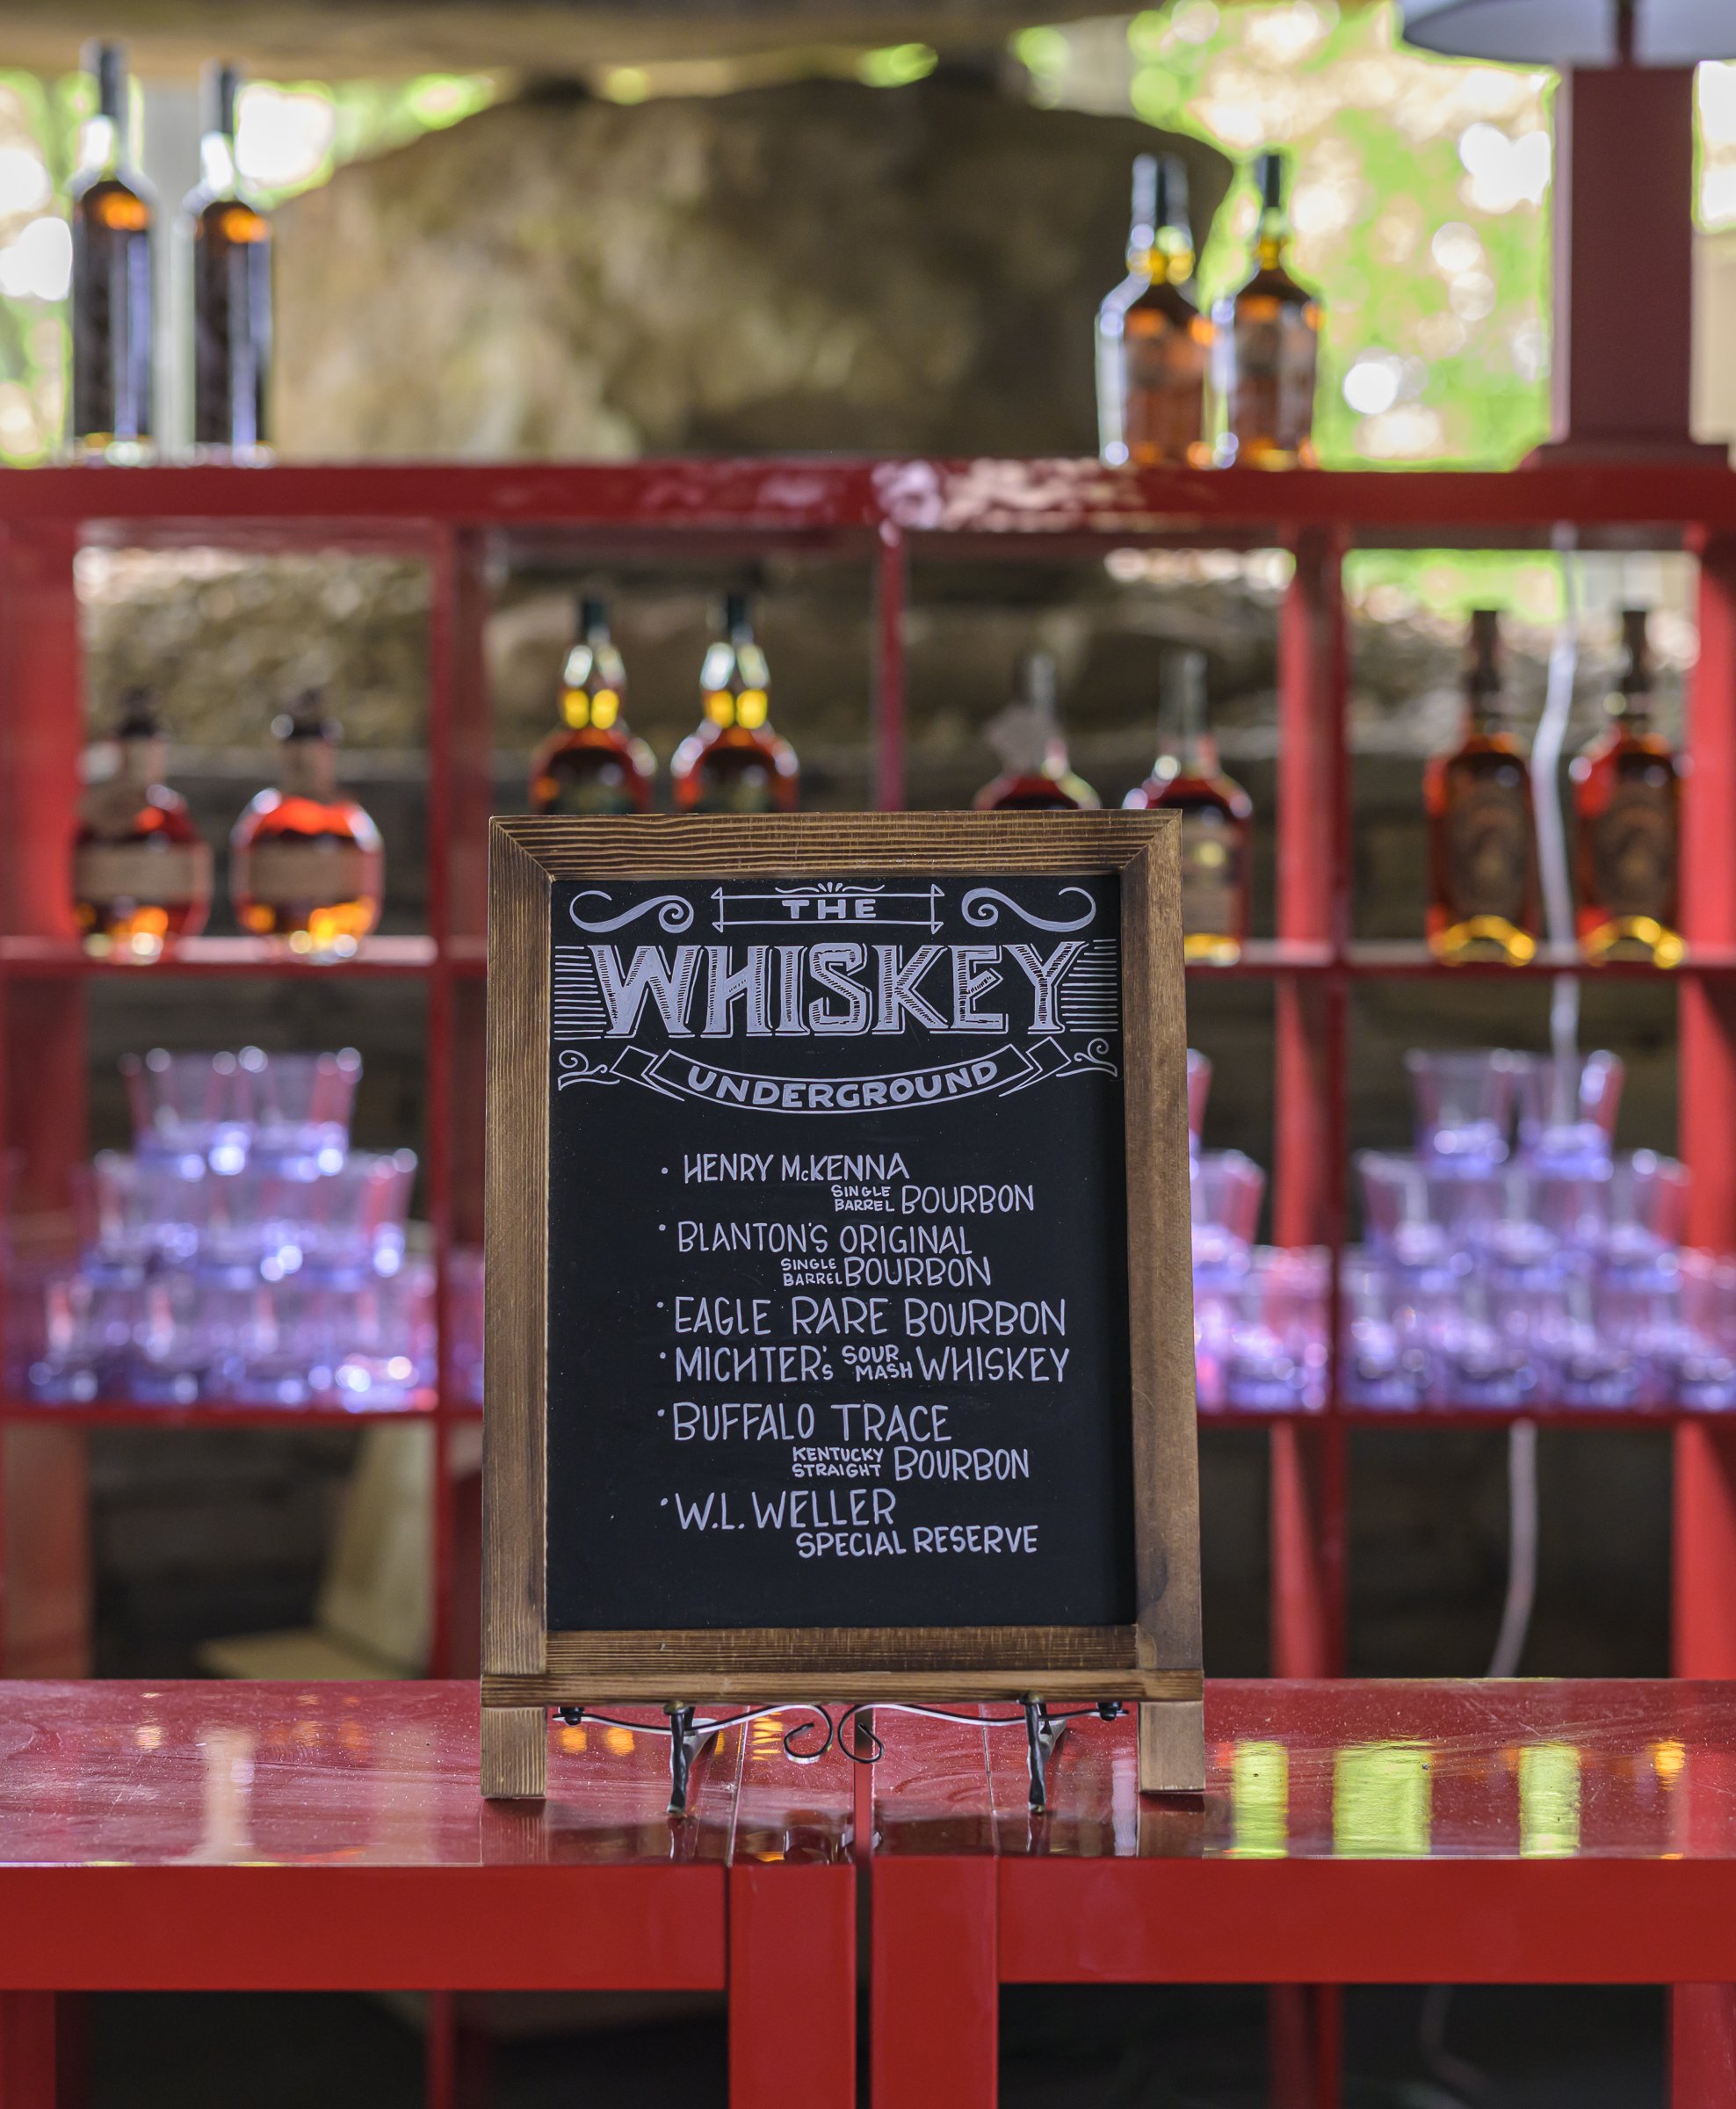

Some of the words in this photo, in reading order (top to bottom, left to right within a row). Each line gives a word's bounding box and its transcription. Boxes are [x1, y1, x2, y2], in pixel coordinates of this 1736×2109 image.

[781, 899, 878, 919] THE
[585, 940, 1090, 1040] WHISKEY
[688, 1060, 998, 1108] UNDERGROUND
[684, 1152, 774, 1185] HENRY
[781, 1152, 910, 1182] McKENNA
[830, 1184, 892, 1198] SINGLE
[834, 1198, 895, 1213] BARREL
[901, 1184, 1034, 1214] BOURBON
[677, 1221, 828, 1253] BLANTON'S
[839, 1224, 973, 1255] ORIGINAL
[780, 1257, 837, 1272] SINGLE
[783, 1272, 843, 1286] BARREL
[843, 1256, 992, 1287] BOURBON
[675, 1295, 771, 1336] EAGLE
[792, 1295, 892, 1336] RARE
[904, 1297, 1066, 1337] BOURBON
[676, 1344, 834, 1383] MICHTER's
[842, 1344, 900, 1365] SOUR
[915, 1345, 1070, 1383] WHISKEY
[855, 1362, 914, 1381] MASH
[673, 1402, 815, 1441] BUFFALO
[830, 1402, 952, 1443] TRACE
[792, 1446, 884, 1463] KENTUCKY
[792, 1462, 881, 1478] STRAIGHT
[893, 1446, 1030, 1482] BOURBON
[675, 1492, 745, 1532] W.L.
[751, 1488, 896, 1530] WELLER
[795, 1530, 908, 1559] SPECIAL
[912, 1525, 1038, 1555] RESERVE
